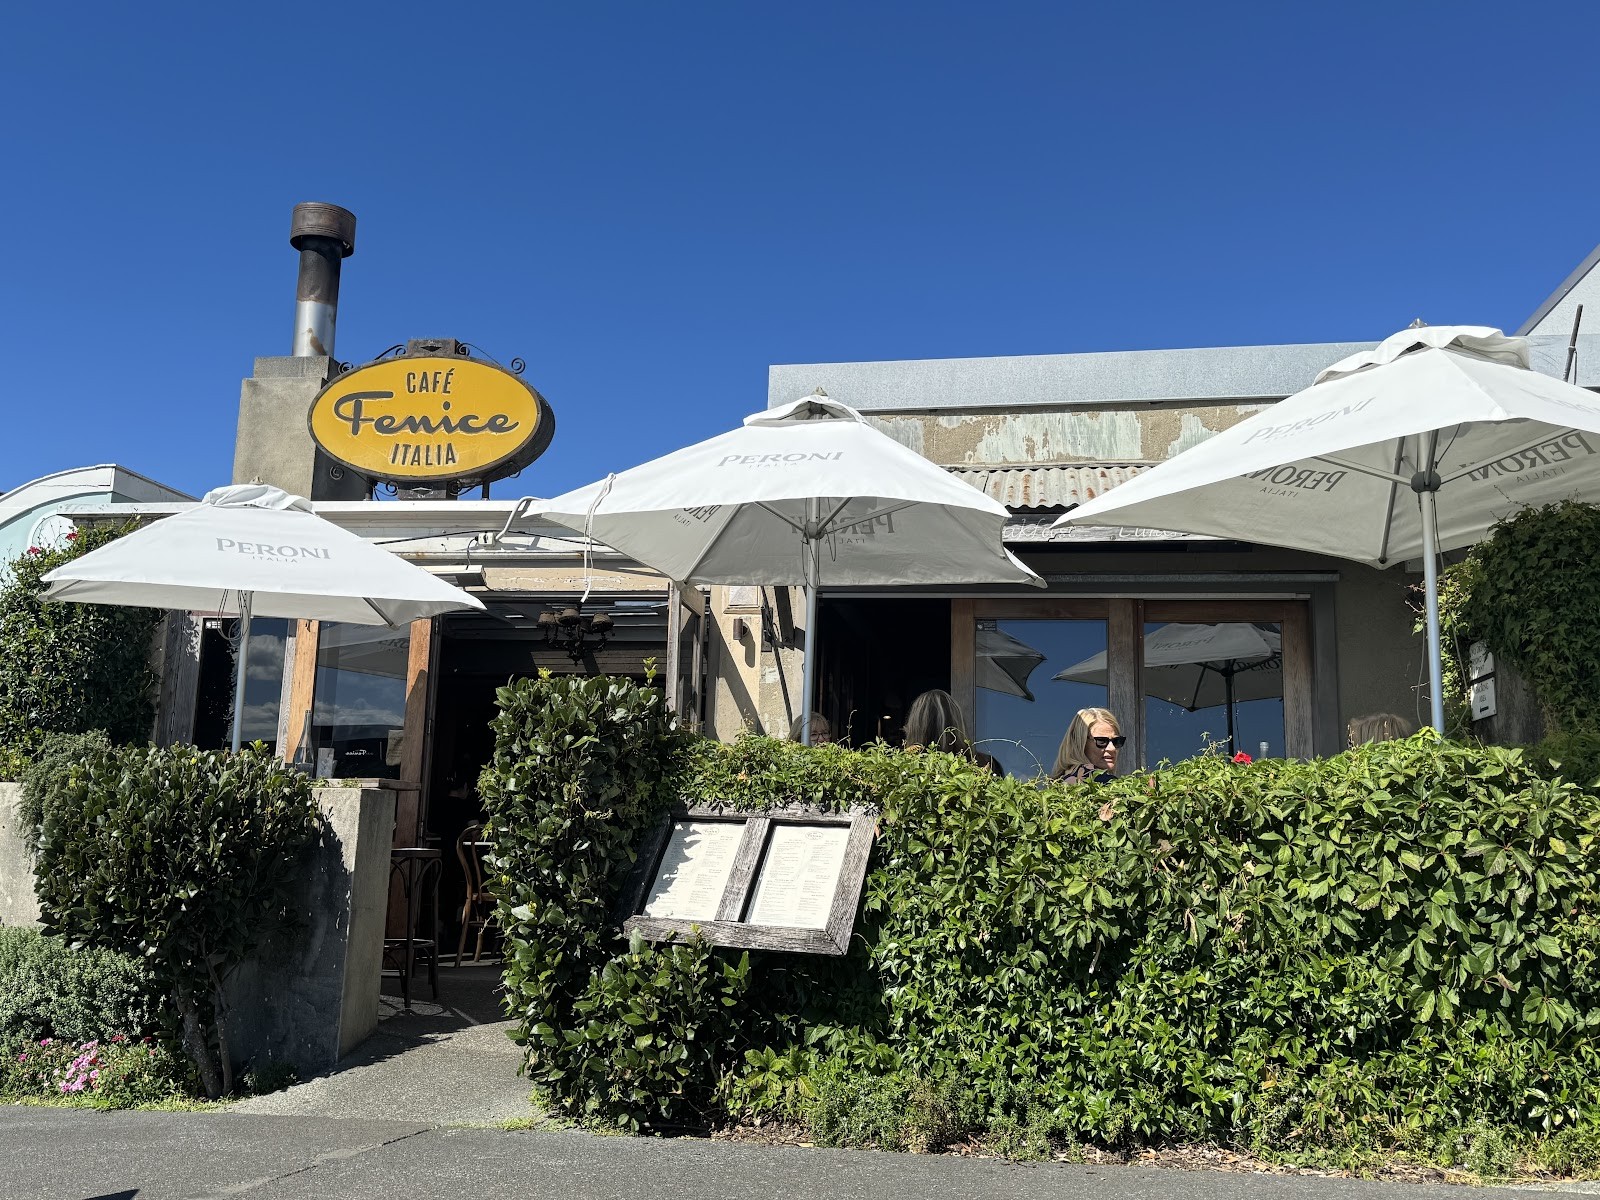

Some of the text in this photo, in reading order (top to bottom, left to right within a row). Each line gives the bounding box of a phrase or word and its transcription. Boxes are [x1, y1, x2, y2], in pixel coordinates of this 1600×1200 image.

[406, 368, 455, 394] CAFÉ
[333, 391, 520, 436] Fenice
[1241, 397, 1377, 446] PERONI
[390, 442, 457, 466] ITALIA
[717, 451, 844, 467] PERONI
[1002, 518, 1077, 539] akfast
[216, 538, 331, 559] PERONI
